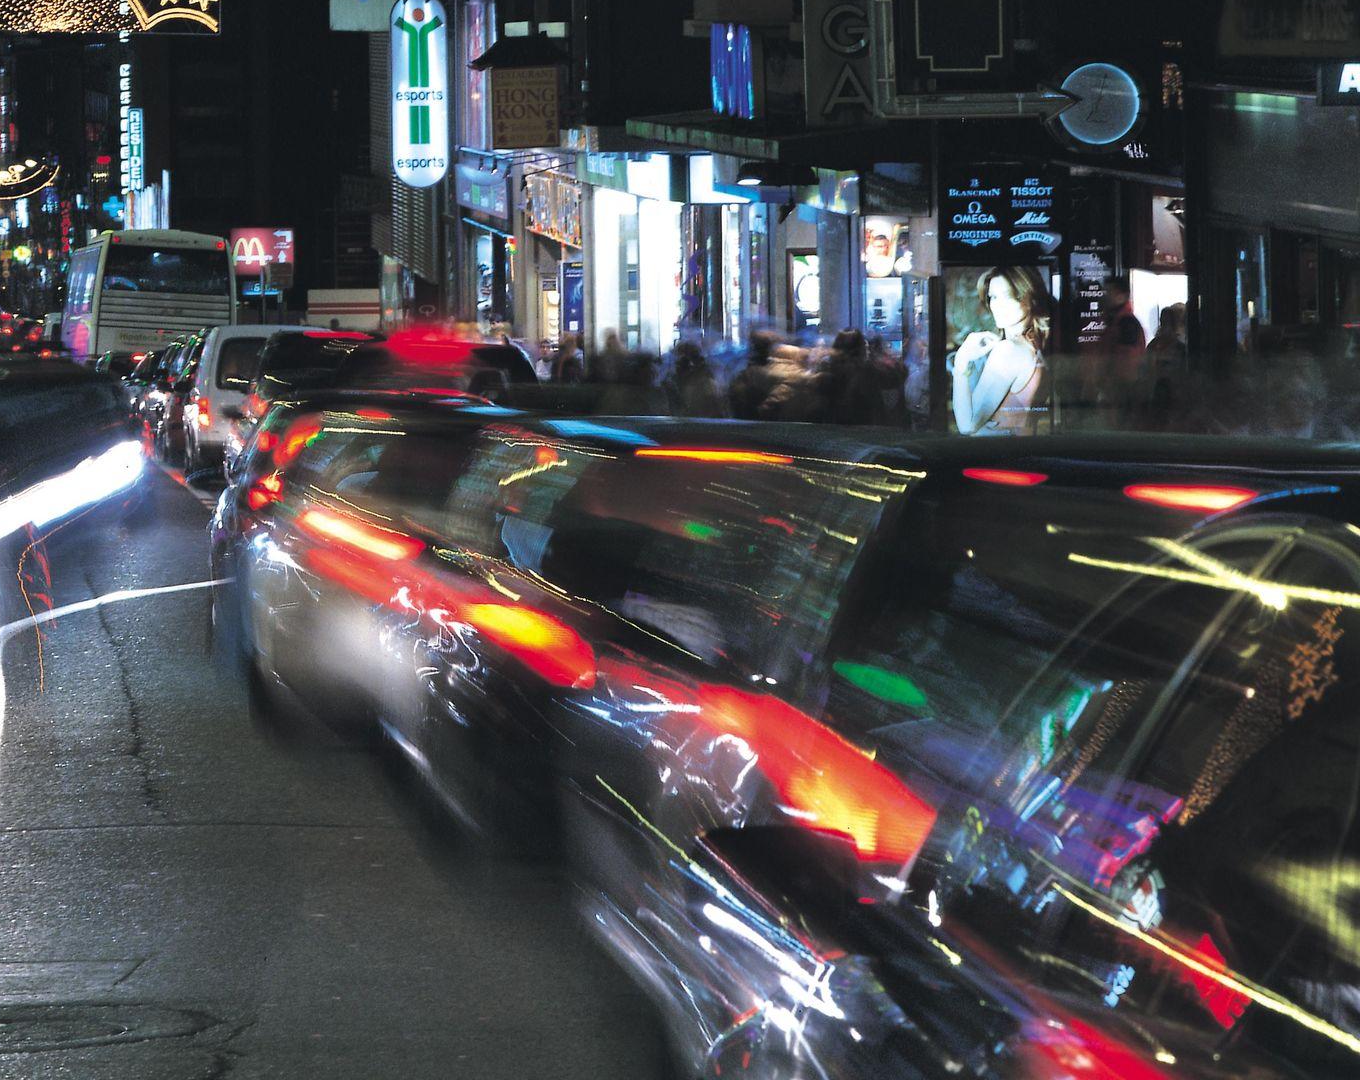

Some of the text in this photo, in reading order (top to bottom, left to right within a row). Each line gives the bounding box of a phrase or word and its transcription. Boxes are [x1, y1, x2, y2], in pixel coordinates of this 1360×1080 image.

[395, 90, 443, 102] esports
[497, 87, 555, 104] HONG
[497, 103, 556, 120] KONG
[397, 157, 445, 170] esports
[948, 188, 1001, 197] BLANCPAIN
[1010, 186, 1053, 196] TISSOT
[1011, 199, 1052, 208] BALMAIN
[953, 214, 996, 224] OMEGA
[948, 230, 1002, 239] LONGINES
